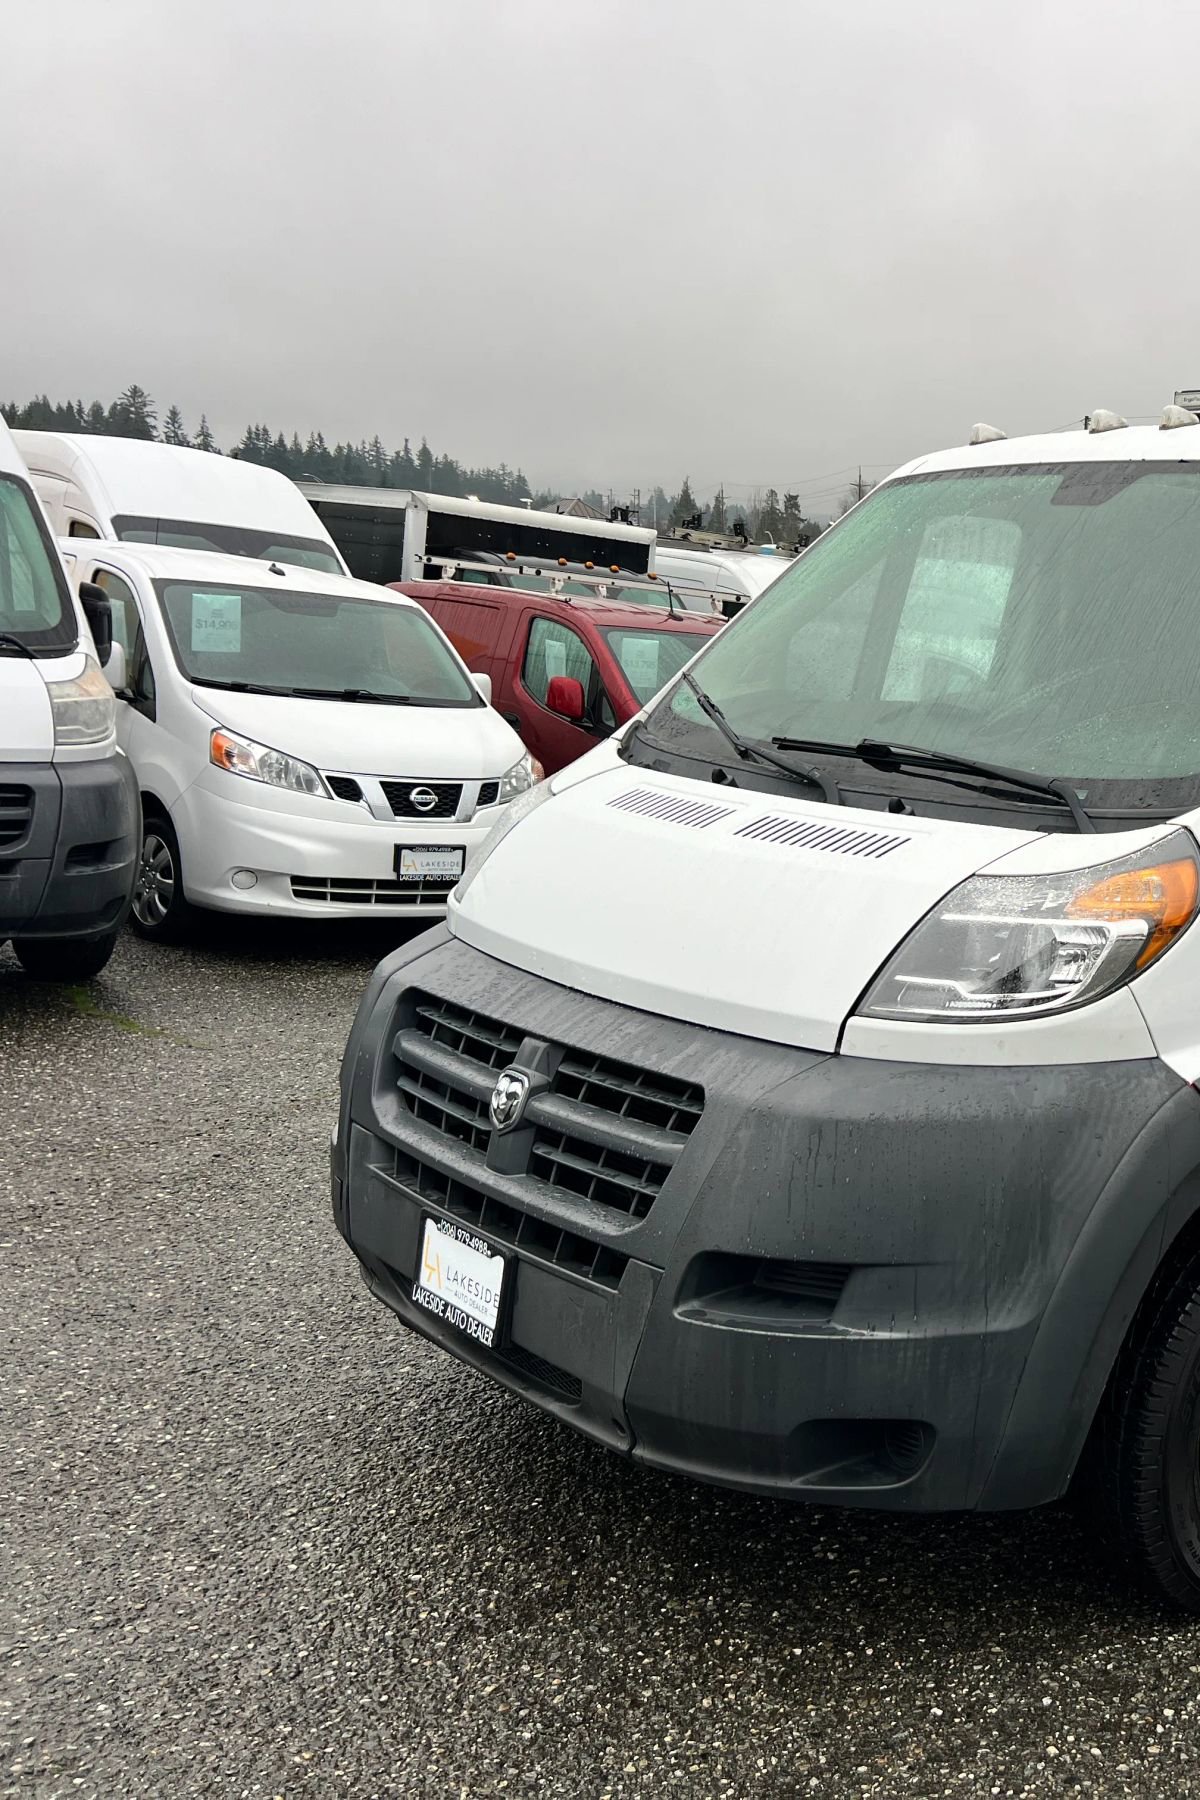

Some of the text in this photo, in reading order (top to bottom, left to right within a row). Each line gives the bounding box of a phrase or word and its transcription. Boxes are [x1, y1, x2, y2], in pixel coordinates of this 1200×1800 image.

[420, 860, 460, 868] LAKESIDE
[457, 1228, 488, 1255] 979-4988
[446, 1265, 500, 1309] LAKESIDE
[412, 1283, 494, 1348] LAKESIDE AUTO DEALER
[454, 1290, 488, 1315] AUTO DEALER
